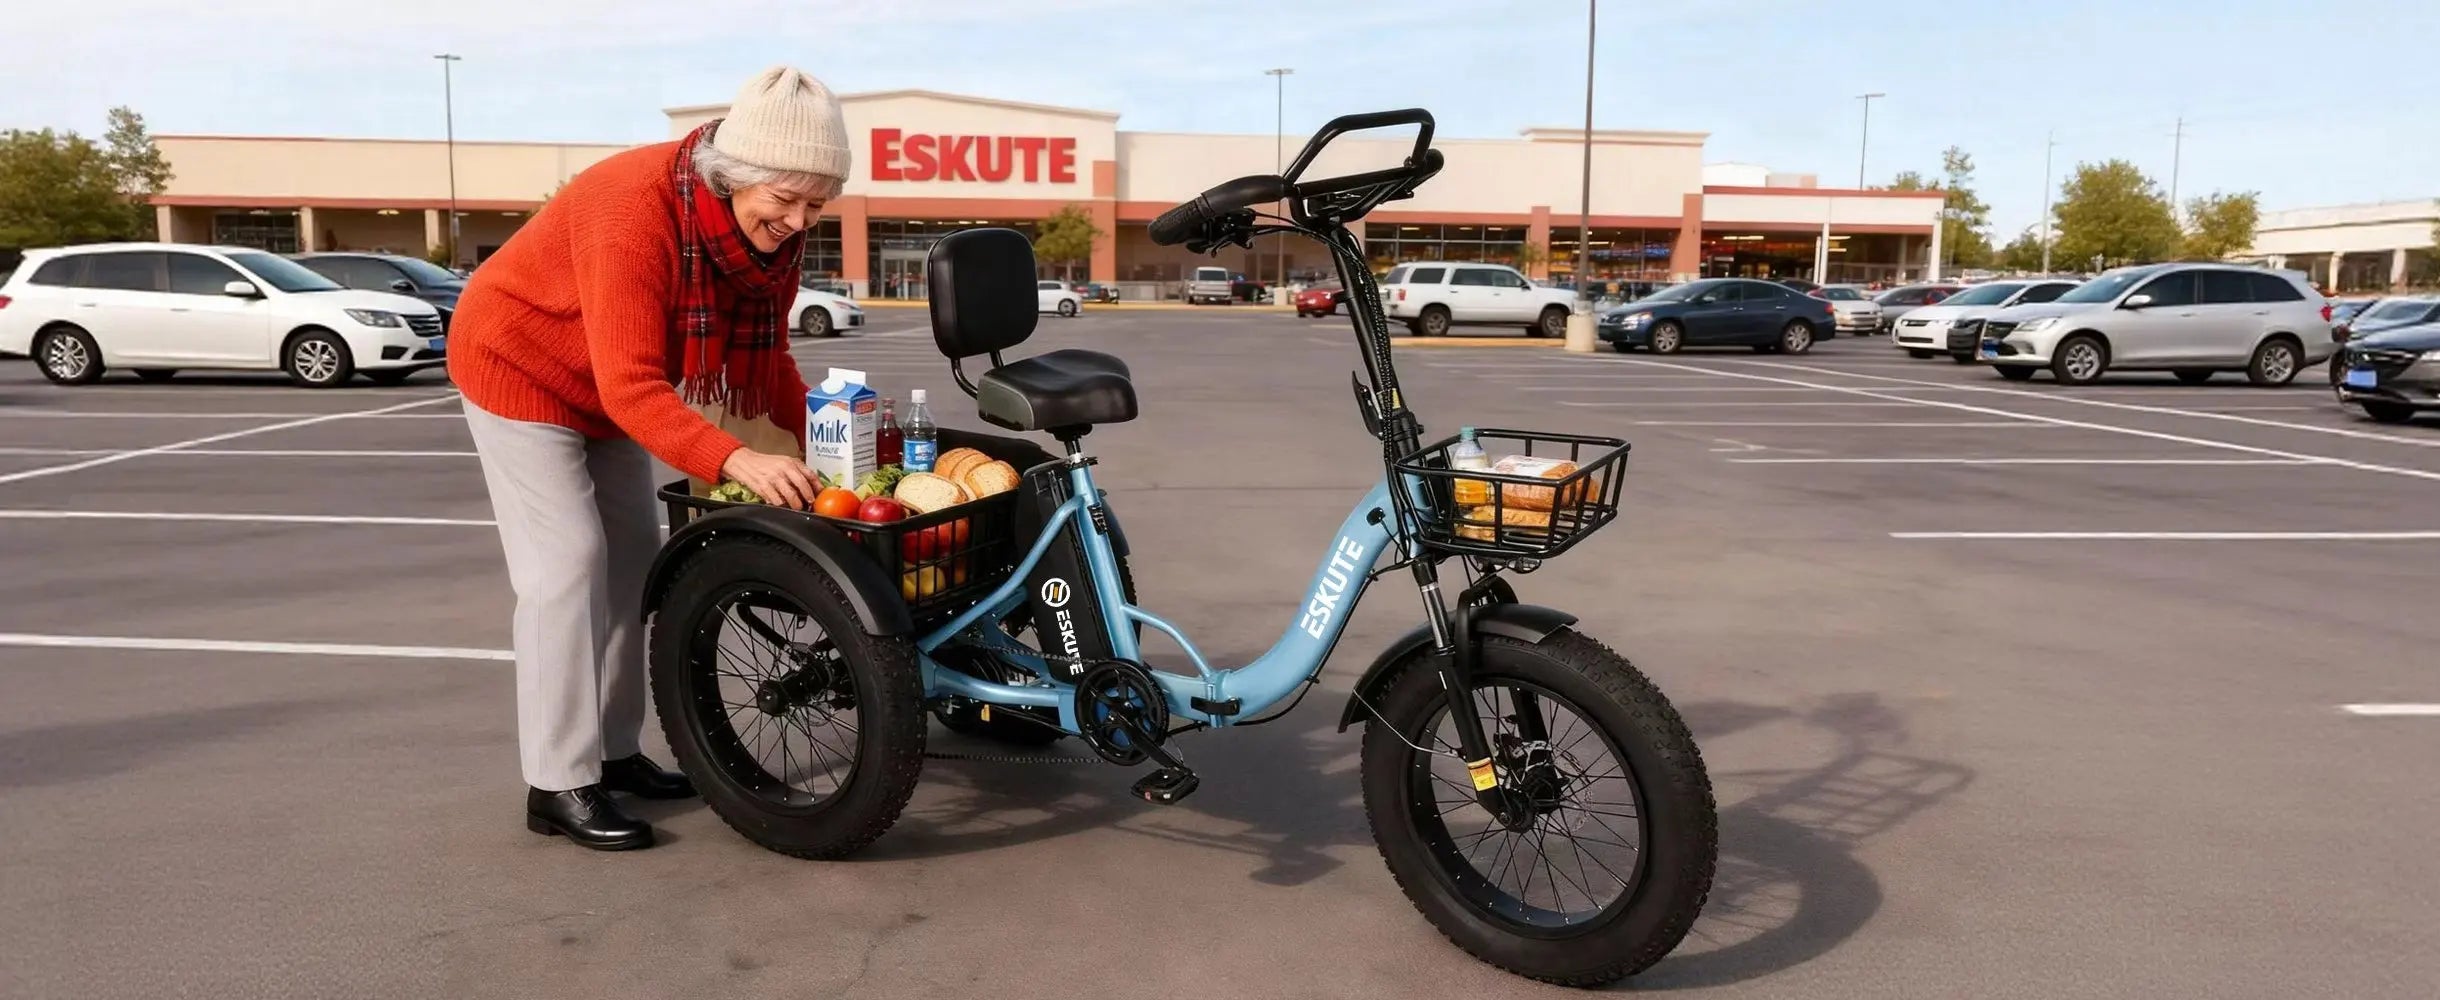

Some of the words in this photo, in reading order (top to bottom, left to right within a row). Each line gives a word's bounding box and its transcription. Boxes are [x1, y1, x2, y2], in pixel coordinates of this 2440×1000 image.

[871, 128, 1076, 183] ESKUTE
[810, 418, 847, 444] Milk
[1300, 535, 1364, 640] ESKUTE
